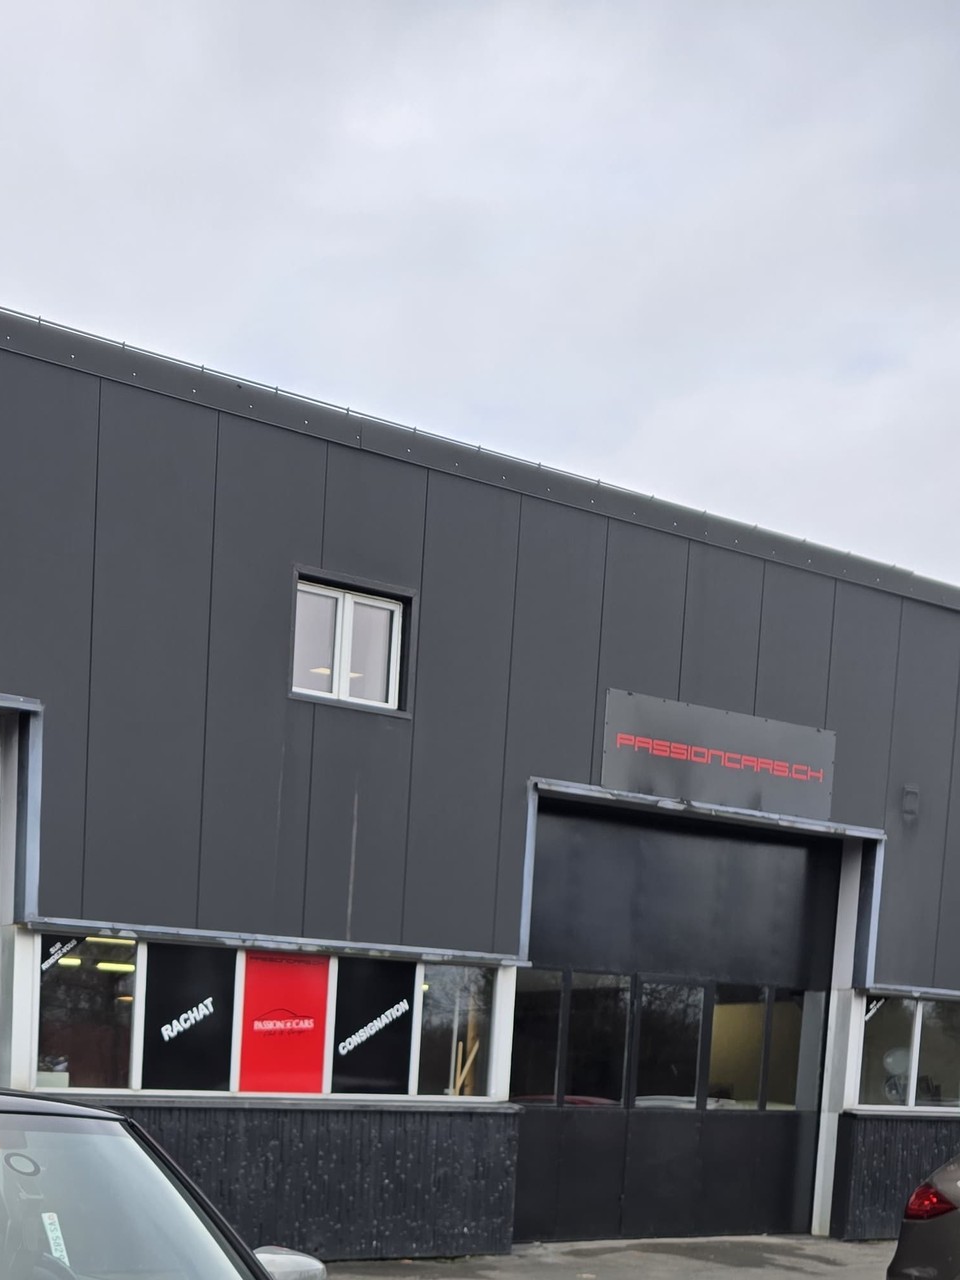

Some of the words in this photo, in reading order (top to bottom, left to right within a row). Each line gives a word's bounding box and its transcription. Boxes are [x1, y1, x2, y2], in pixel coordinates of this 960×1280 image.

[616, 732, 824, 783] PASSIONCARS.CH
[161, 997, 215, 1042] RACHAT
[338, 999, 409, 1056] CONSIGNATION
